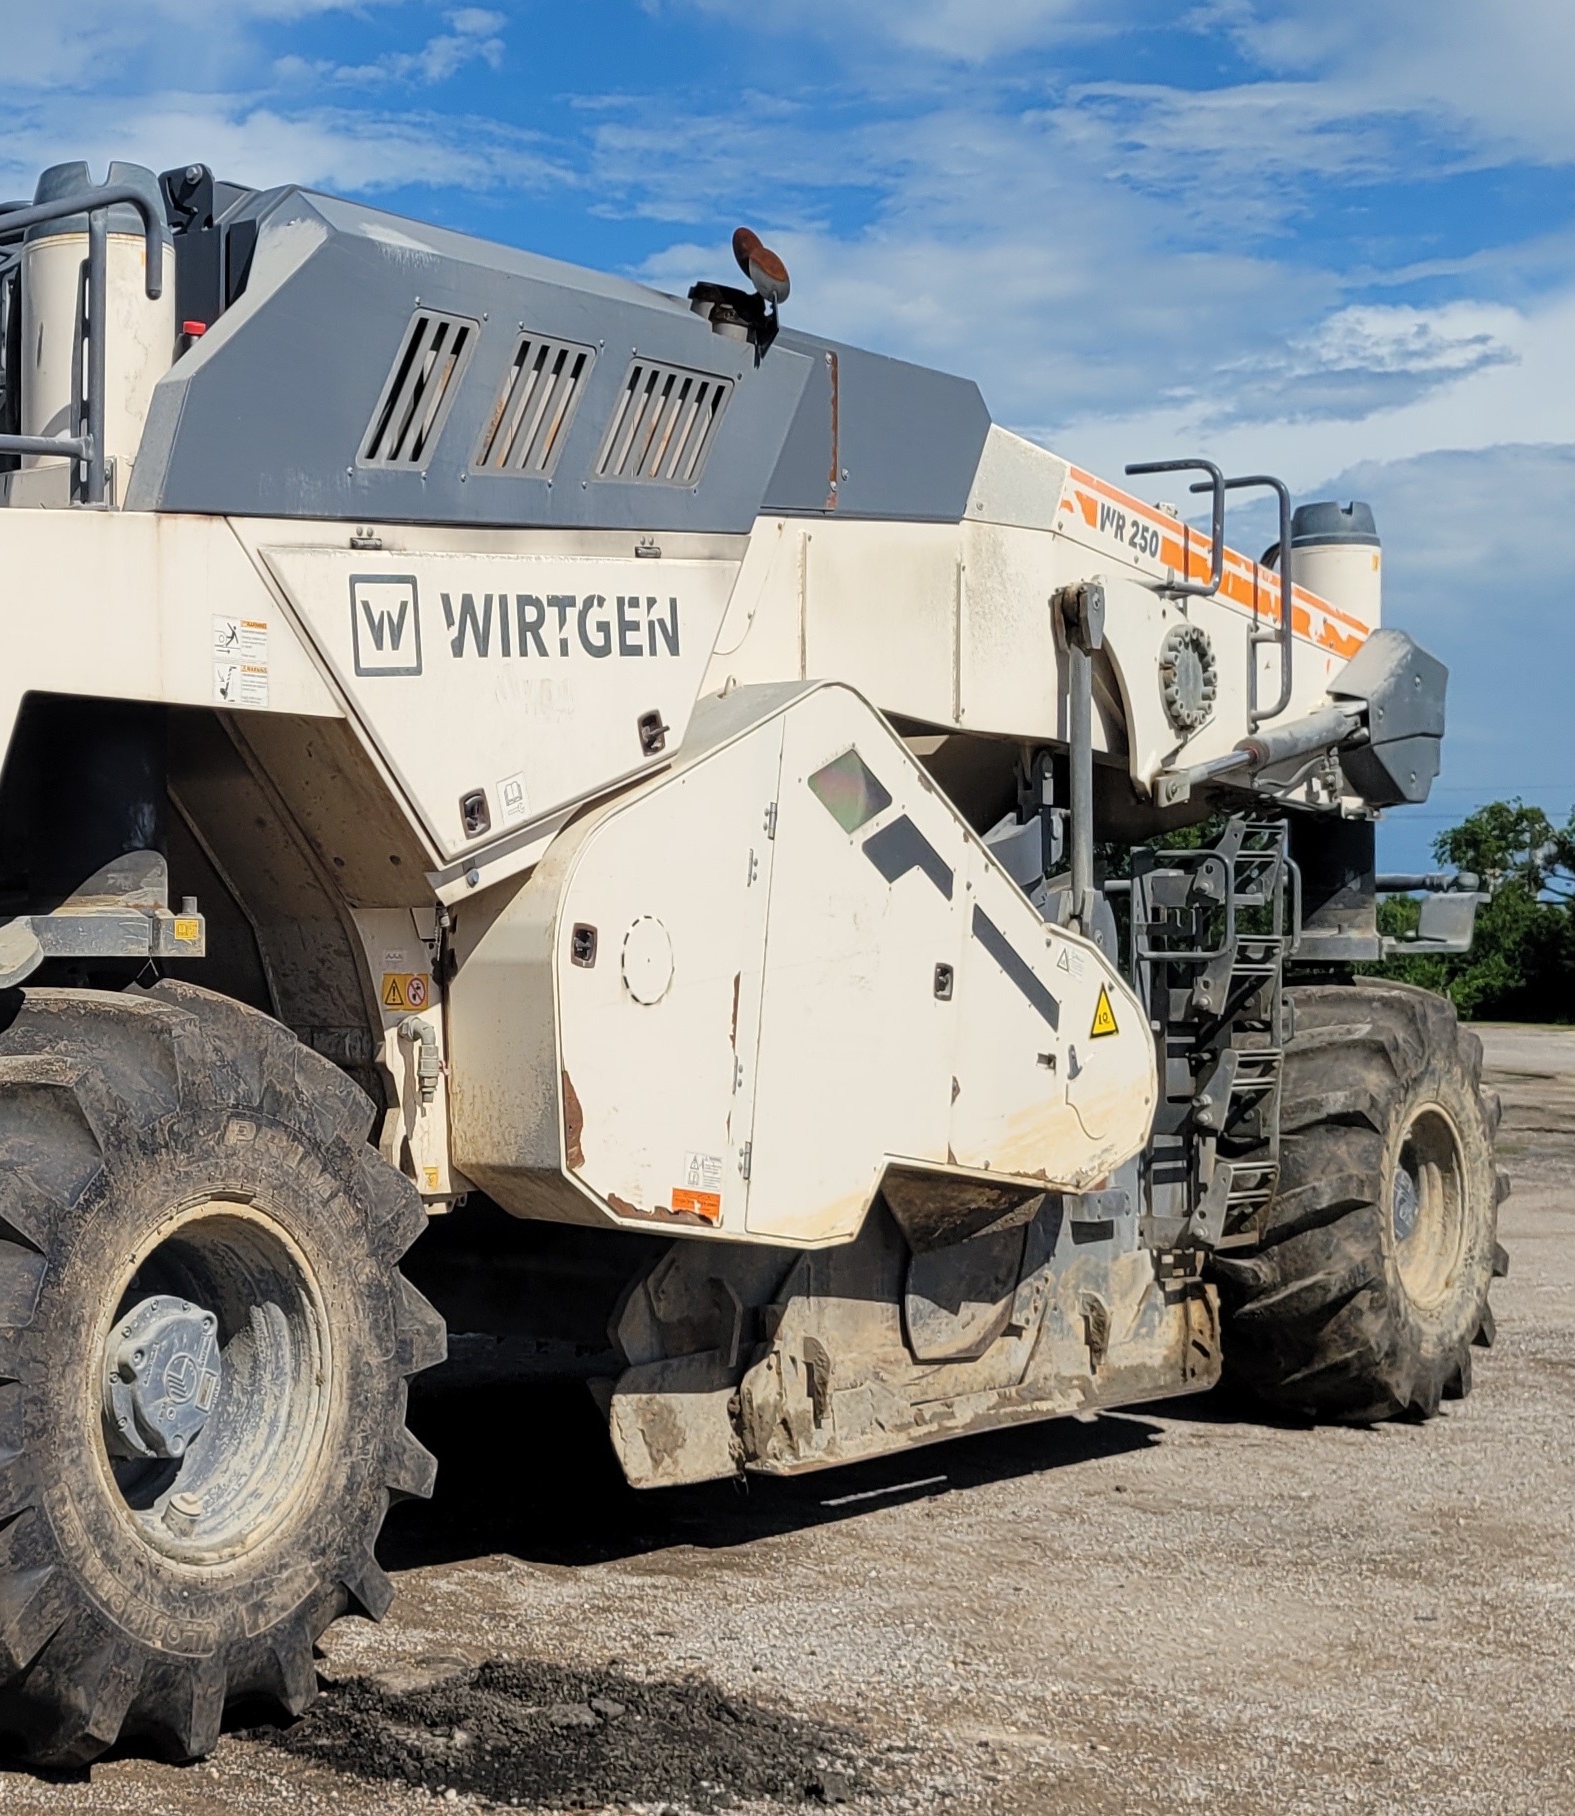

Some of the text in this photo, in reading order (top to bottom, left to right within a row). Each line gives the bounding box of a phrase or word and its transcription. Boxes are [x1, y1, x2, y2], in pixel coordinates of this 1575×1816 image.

[1100, 502, 1159, 558] WR 250
[440, 592, 681, 658] WIRTGEN
